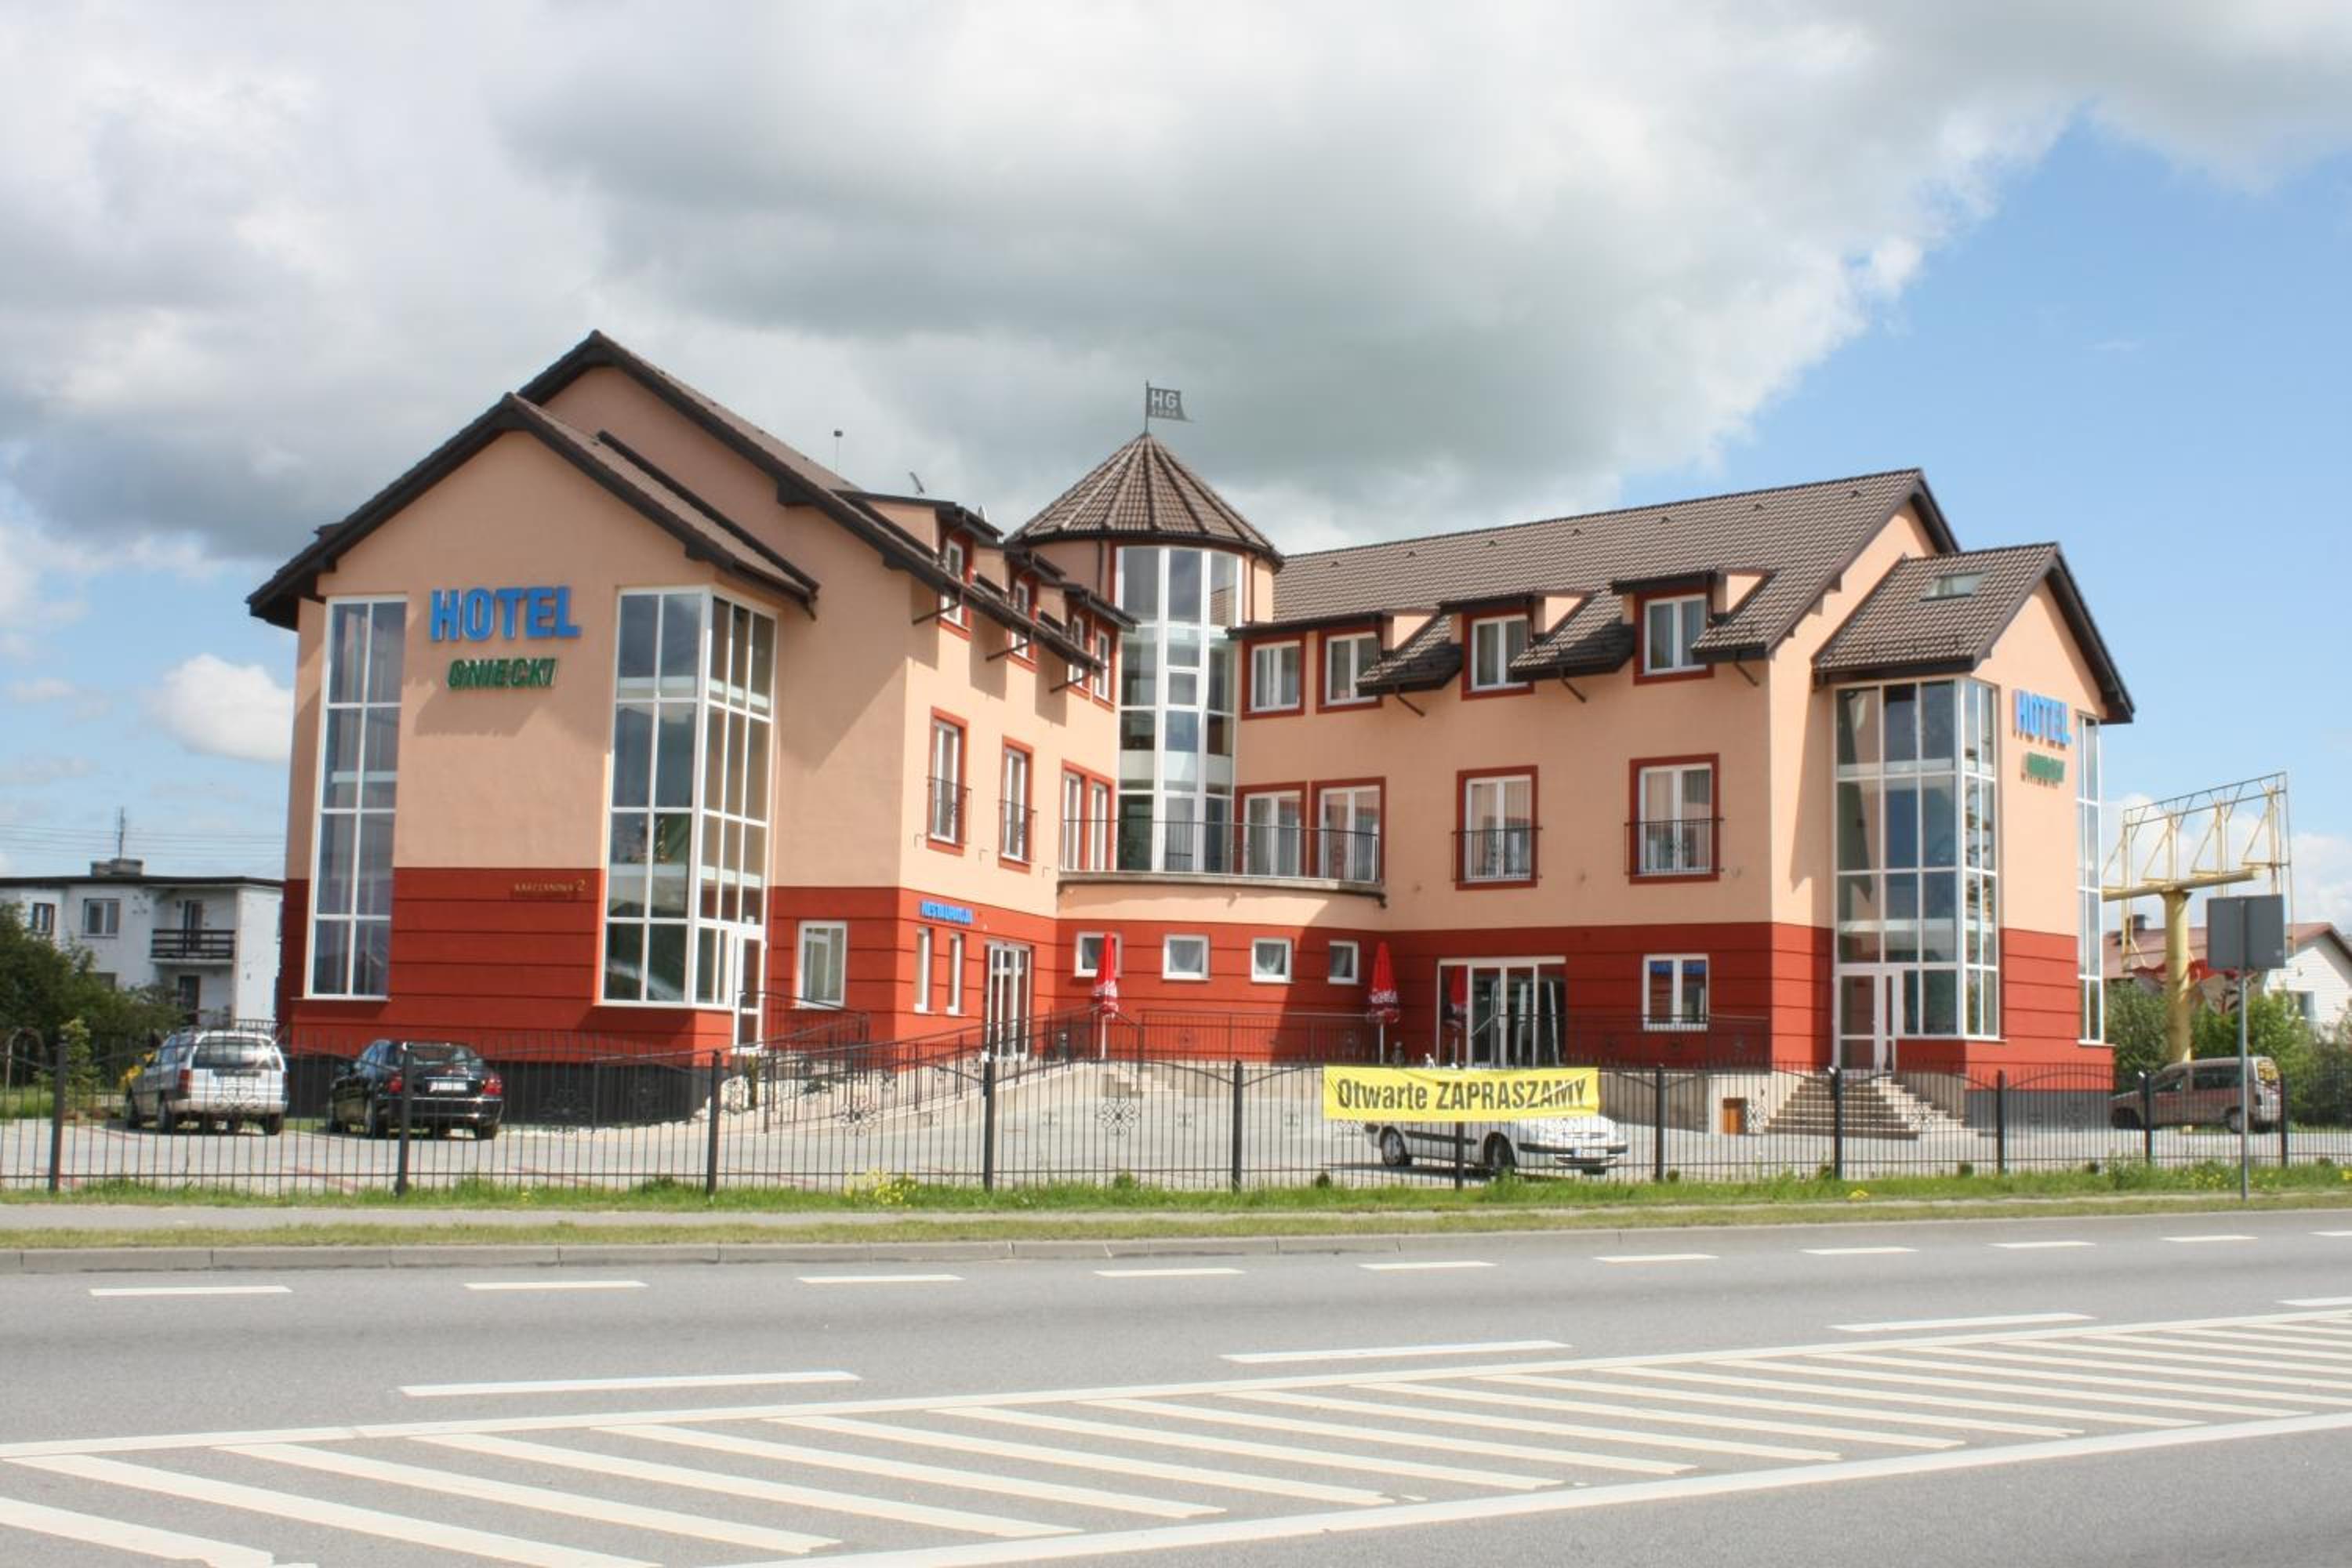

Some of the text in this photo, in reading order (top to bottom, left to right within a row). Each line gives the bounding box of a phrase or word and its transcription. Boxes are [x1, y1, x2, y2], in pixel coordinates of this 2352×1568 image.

[1151, 390, 1178, 408] HG
[430, 586, 582, 641] HOTEL
[447, 658, 559, 690] GNIECKI
[2014, 689, 2072, 745] HOTEL
[1337, 1078, 1586, 1111] Otwarte ZAPRASZAMY
